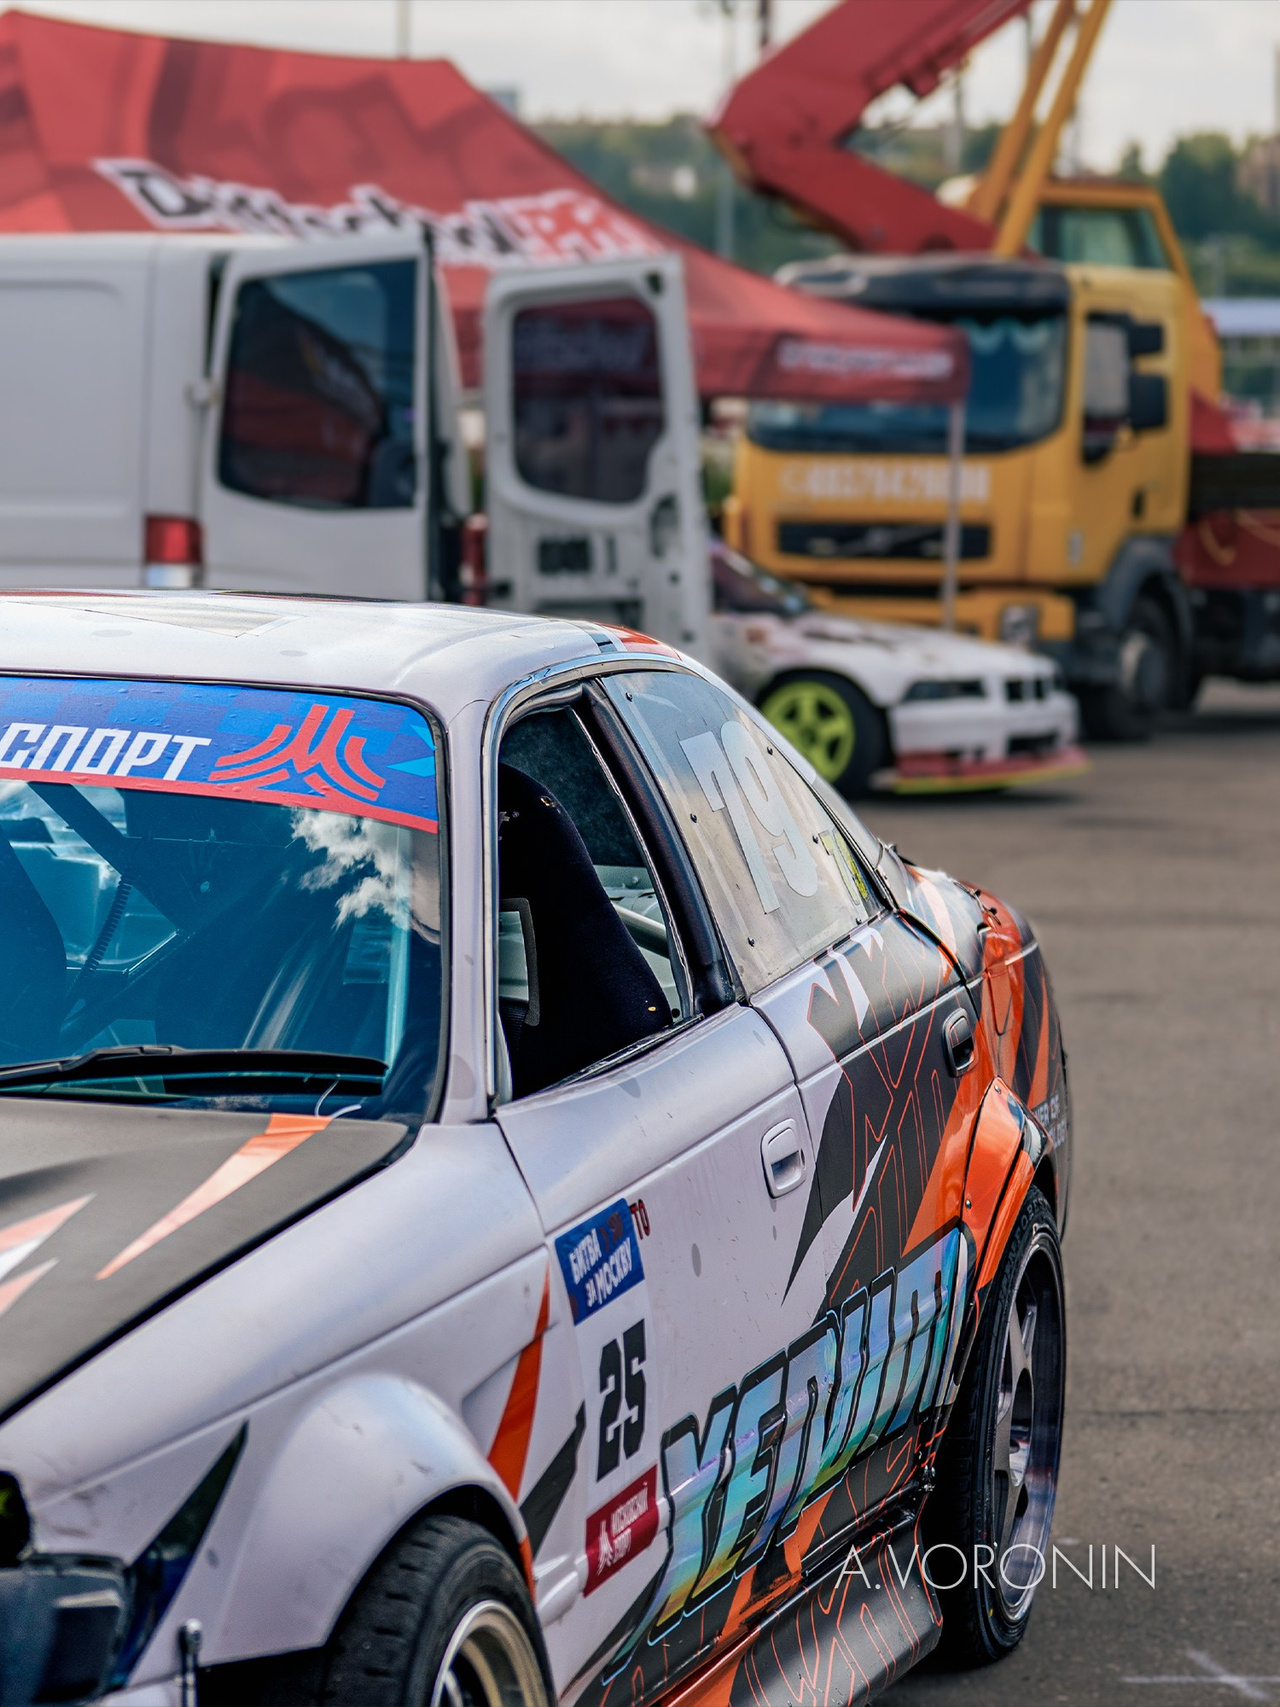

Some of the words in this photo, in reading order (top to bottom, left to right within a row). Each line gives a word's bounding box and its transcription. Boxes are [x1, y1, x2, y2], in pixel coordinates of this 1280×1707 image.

[680, 720, 819, 915] 79
[568, 1227, 603, 1286] БИТВА
[584, 1277, 600, 1308] ЗА
[593, 1236, 633, 1306] МОСКВУ
[596, 1318, 647, 1483] 25
